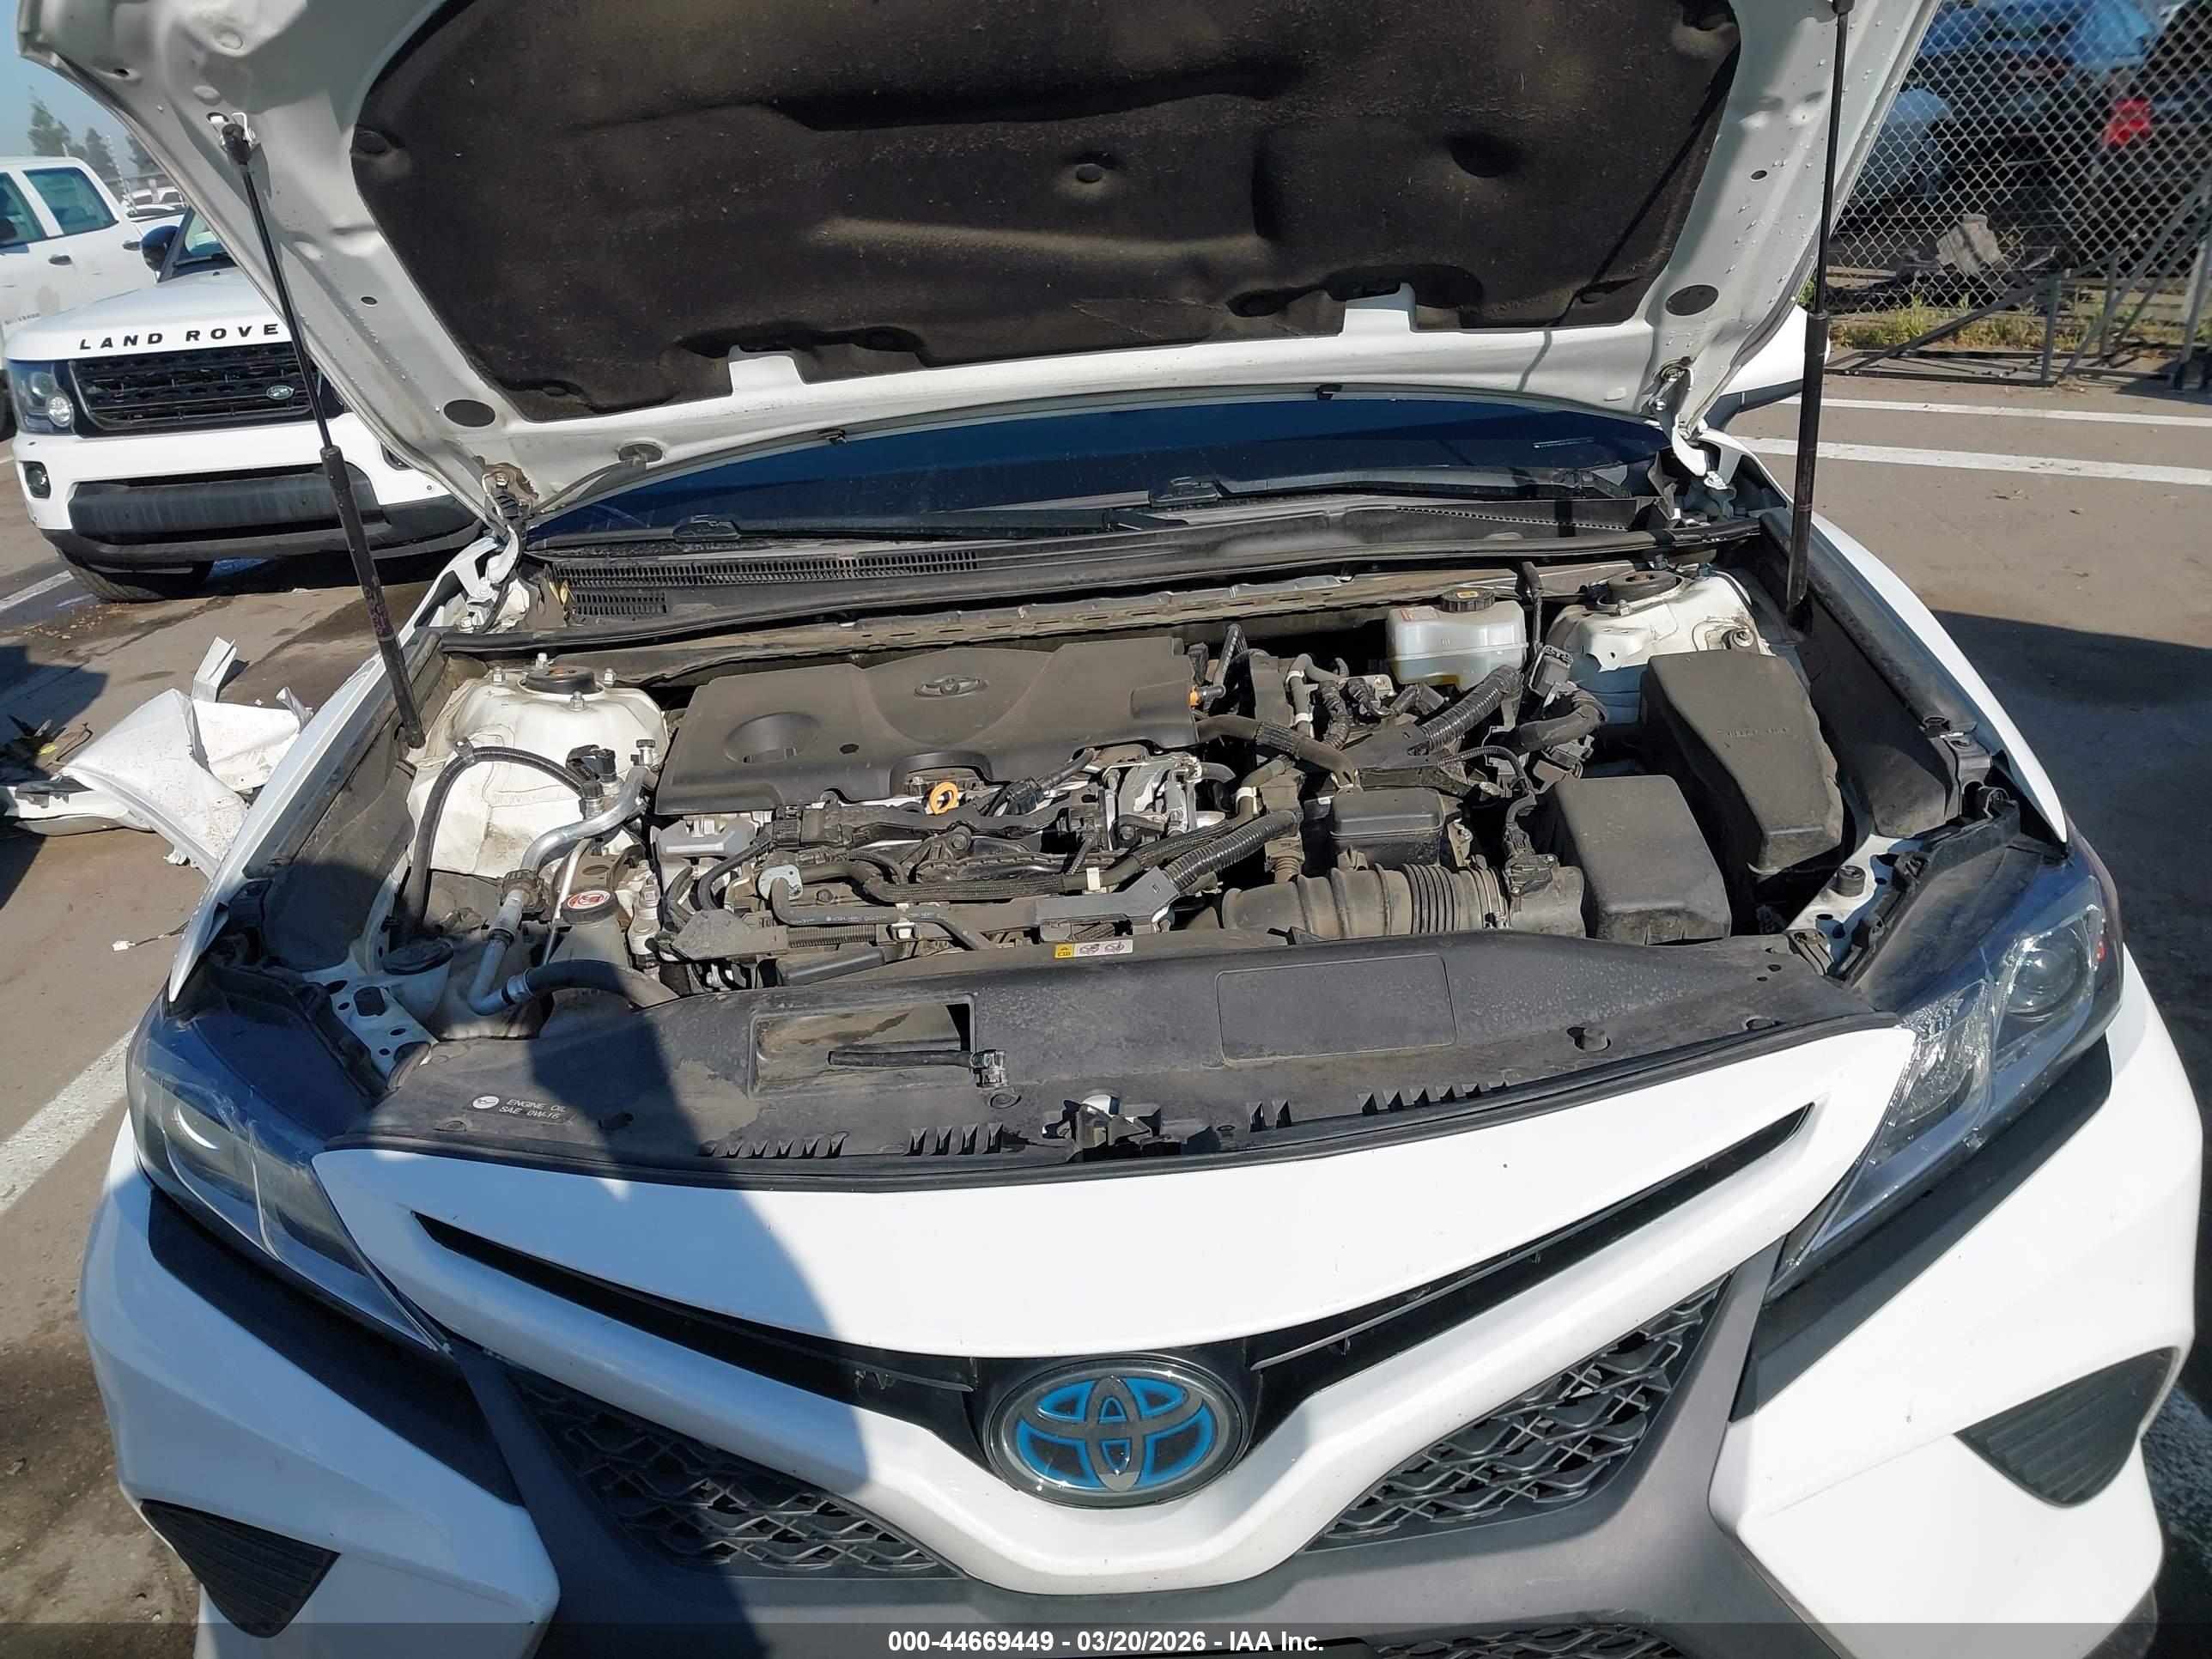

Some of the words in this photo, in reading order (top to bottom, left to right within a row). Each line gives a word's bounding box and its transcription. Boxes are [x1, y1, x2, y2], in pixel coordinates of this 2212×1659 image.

[80, 332, 163, 350] LAND
[185, 323, 279, 342] ROVE
[498, 1106, 522, 1115] SAE
[526, 1109, 561, 1120] 0W-16
[506, 1098, 547, 1110] ENGINE
[550, 1104, 567, 1113] OIL
